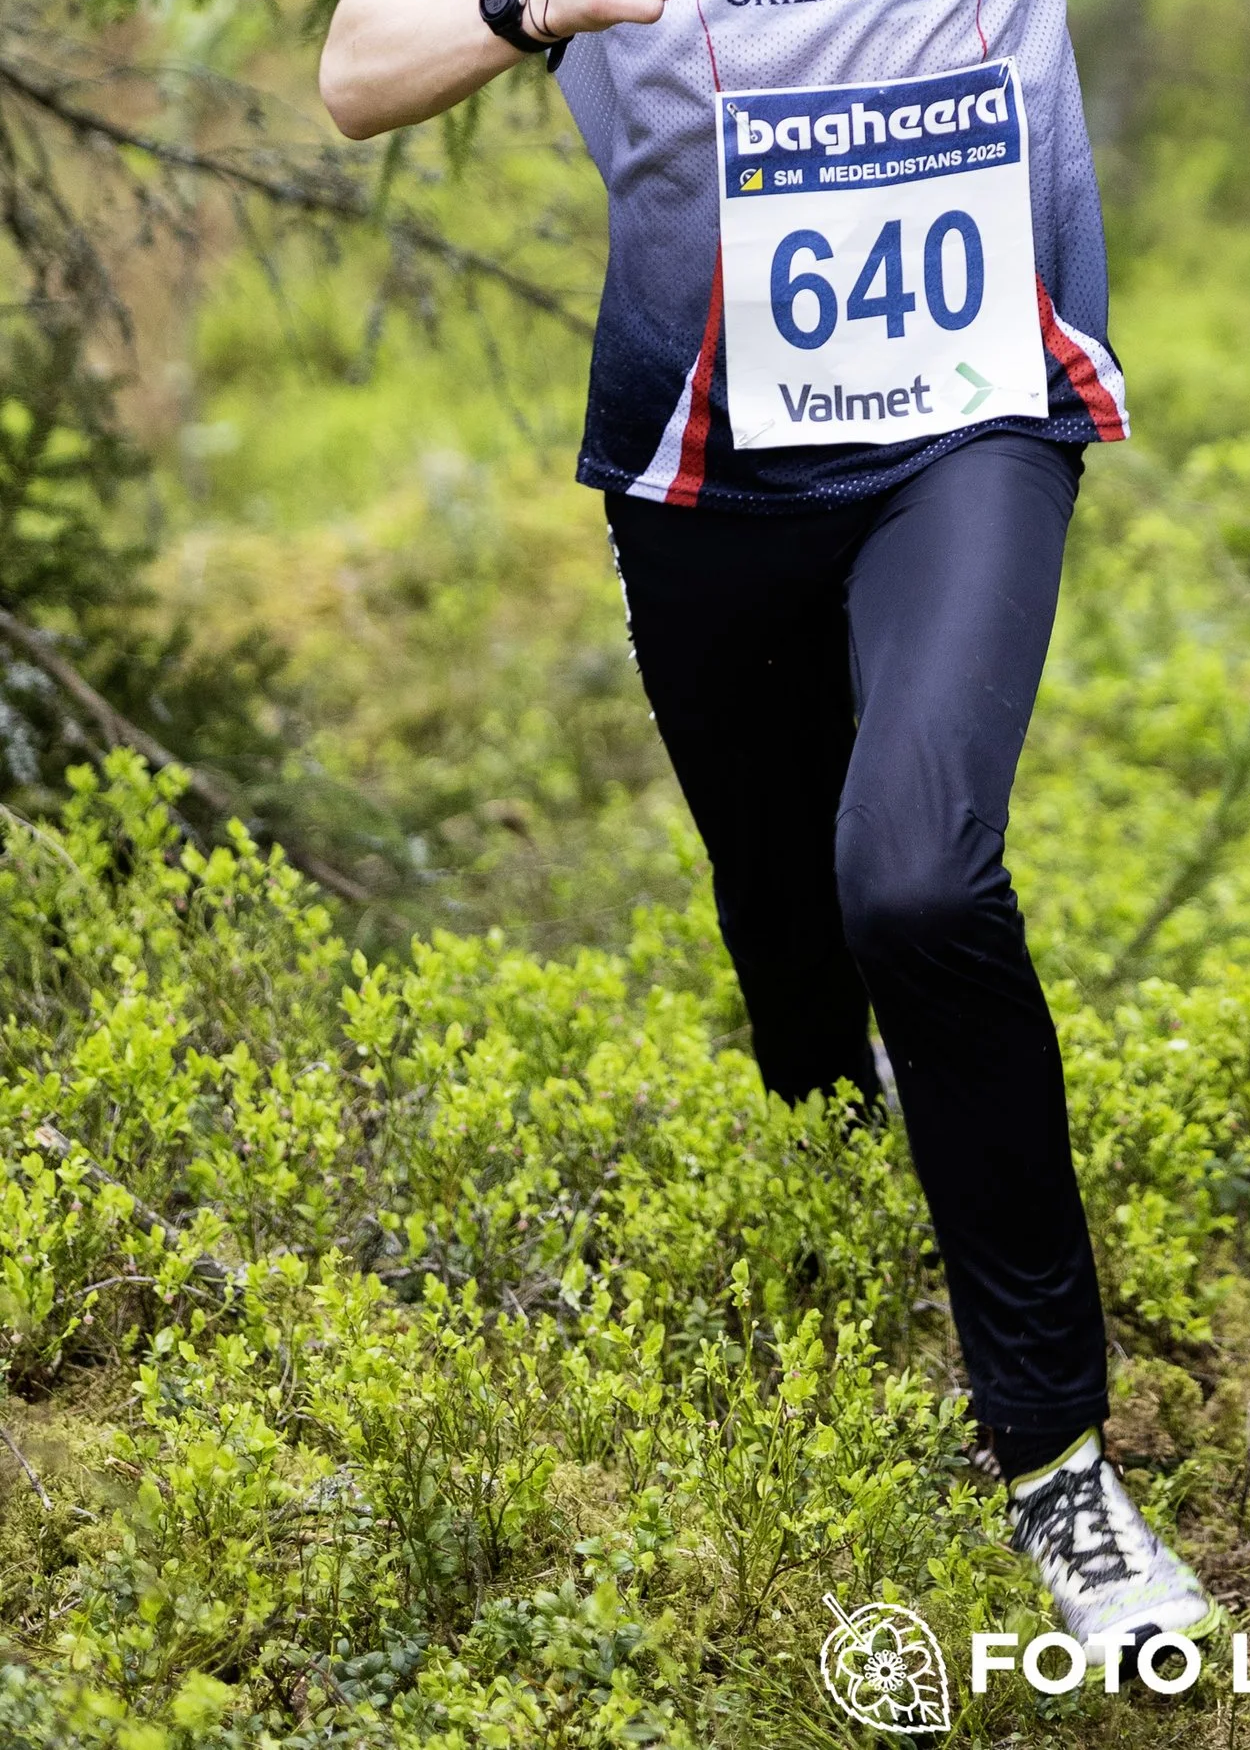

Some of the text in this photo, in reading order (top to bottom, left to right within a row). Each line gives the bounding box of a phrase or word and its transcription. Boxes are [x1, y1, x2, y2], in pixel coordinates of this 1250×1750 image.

[736, 87, 1010, 156] bagheera
[774, 142, 1007, 186] SM MEDELDISTANS 2025
[769, 209, 985, 351] 640
[778, 374, 934, 423] Valmet
